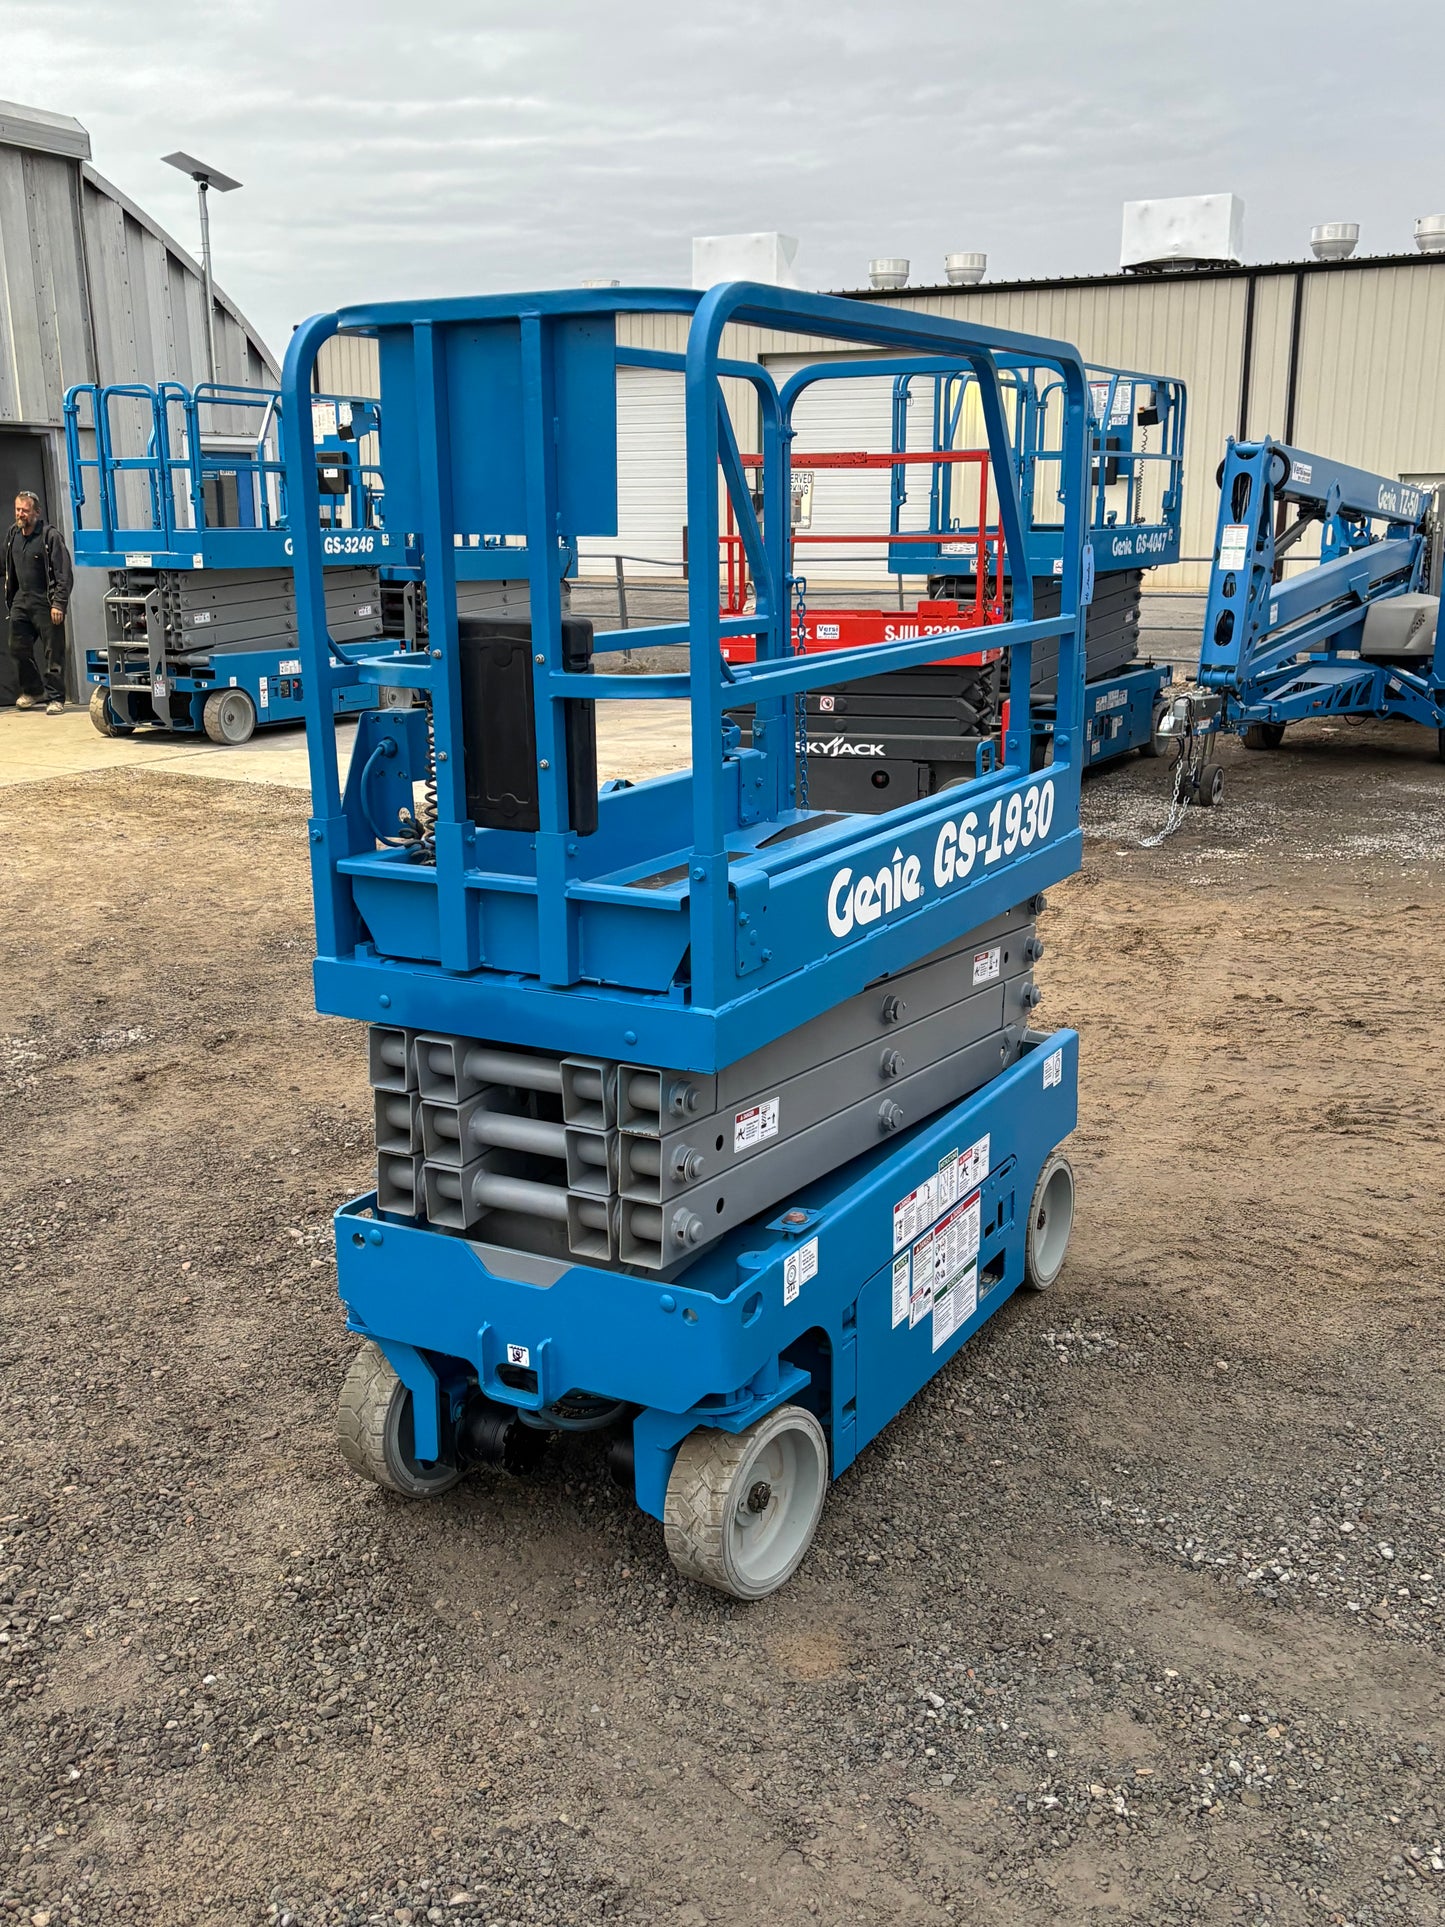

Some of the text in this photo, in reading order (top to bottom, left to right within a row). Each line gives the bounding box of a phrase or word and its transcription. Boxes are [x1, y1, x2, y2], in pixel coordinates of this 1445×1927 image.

[790, 473, 813, 484] ERVED
[1378, 483, 1419, 517] Genie TZ-50
[324, 536, 374, 554] GS-3246
[1112, 532, 1168, 557] Genie GS-4047
[795, 736, 886, 757] SKYJACK
[827, 779, 1055, 938] Genie GS-1930
